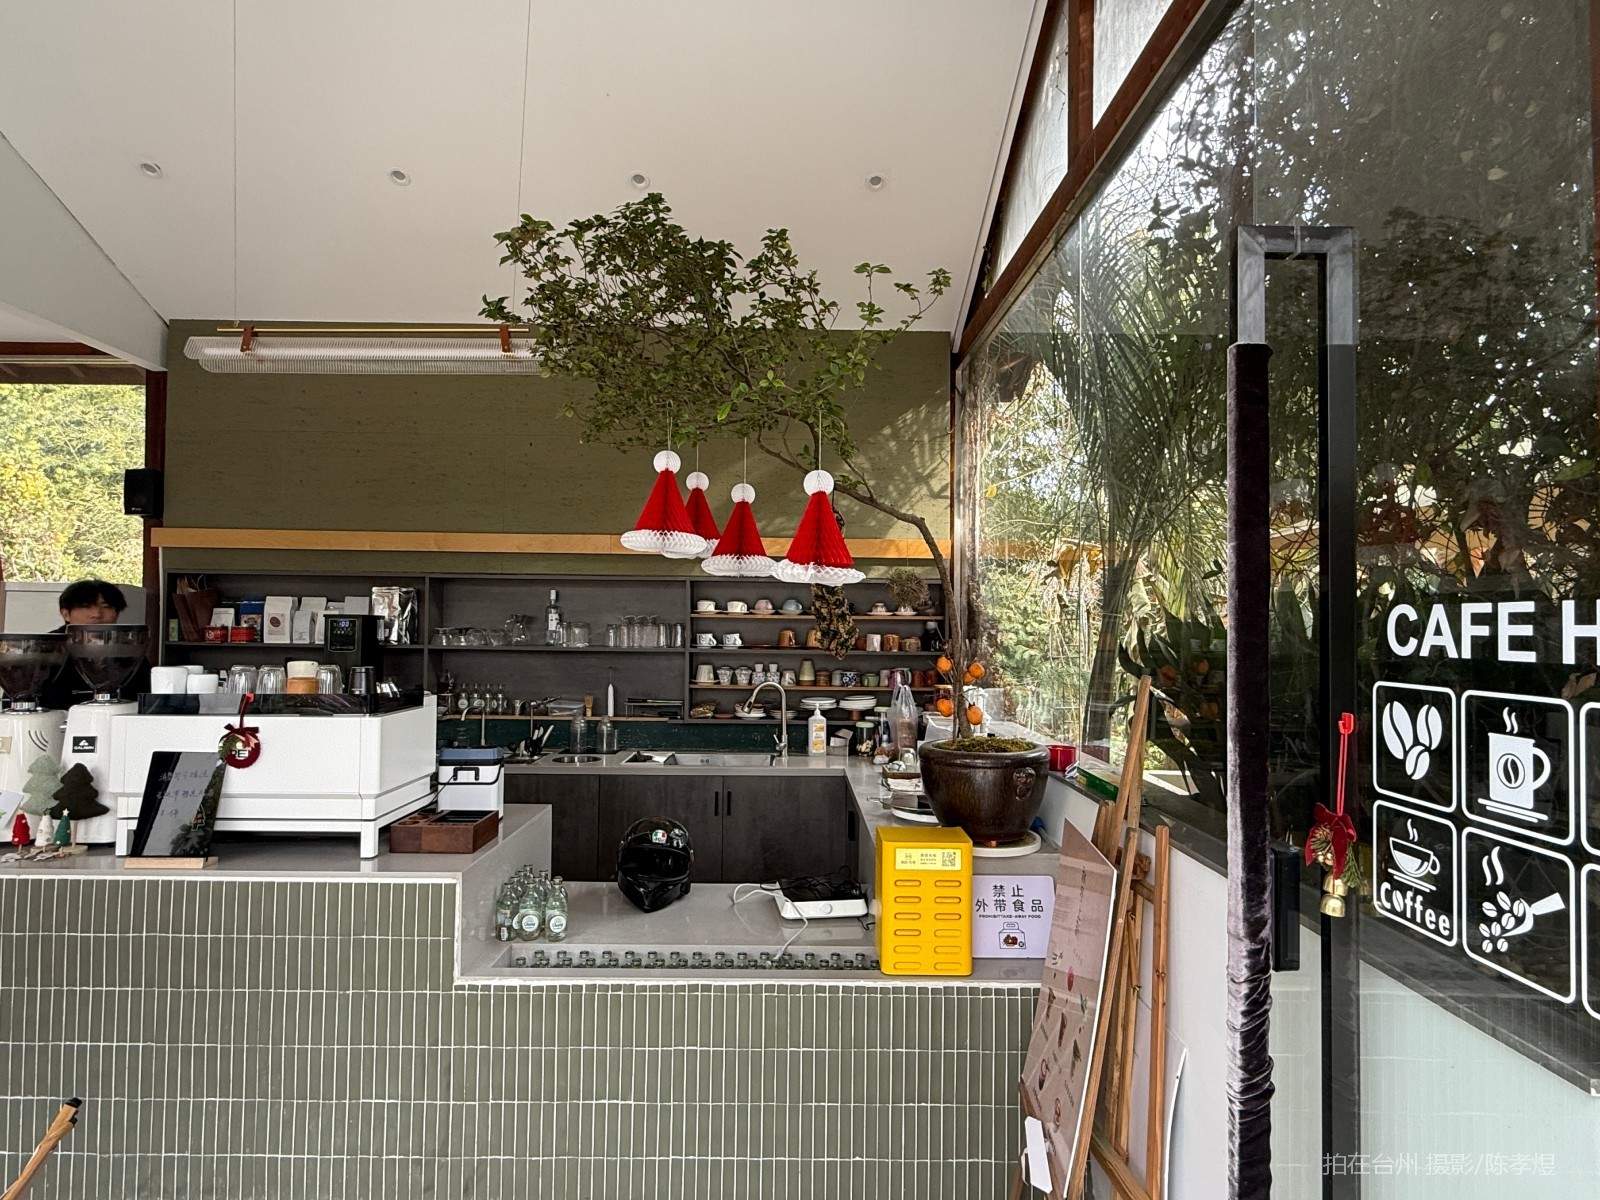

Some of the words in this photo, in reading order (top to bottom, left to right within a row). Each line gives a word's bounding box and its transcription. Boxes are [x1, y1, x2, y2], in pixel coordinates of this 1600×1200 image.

[1386, 601, 1537, 663] CAFE
[992, 884, 1024, 898] 禁止
[975, 898, 1044, 912] 外带食品
